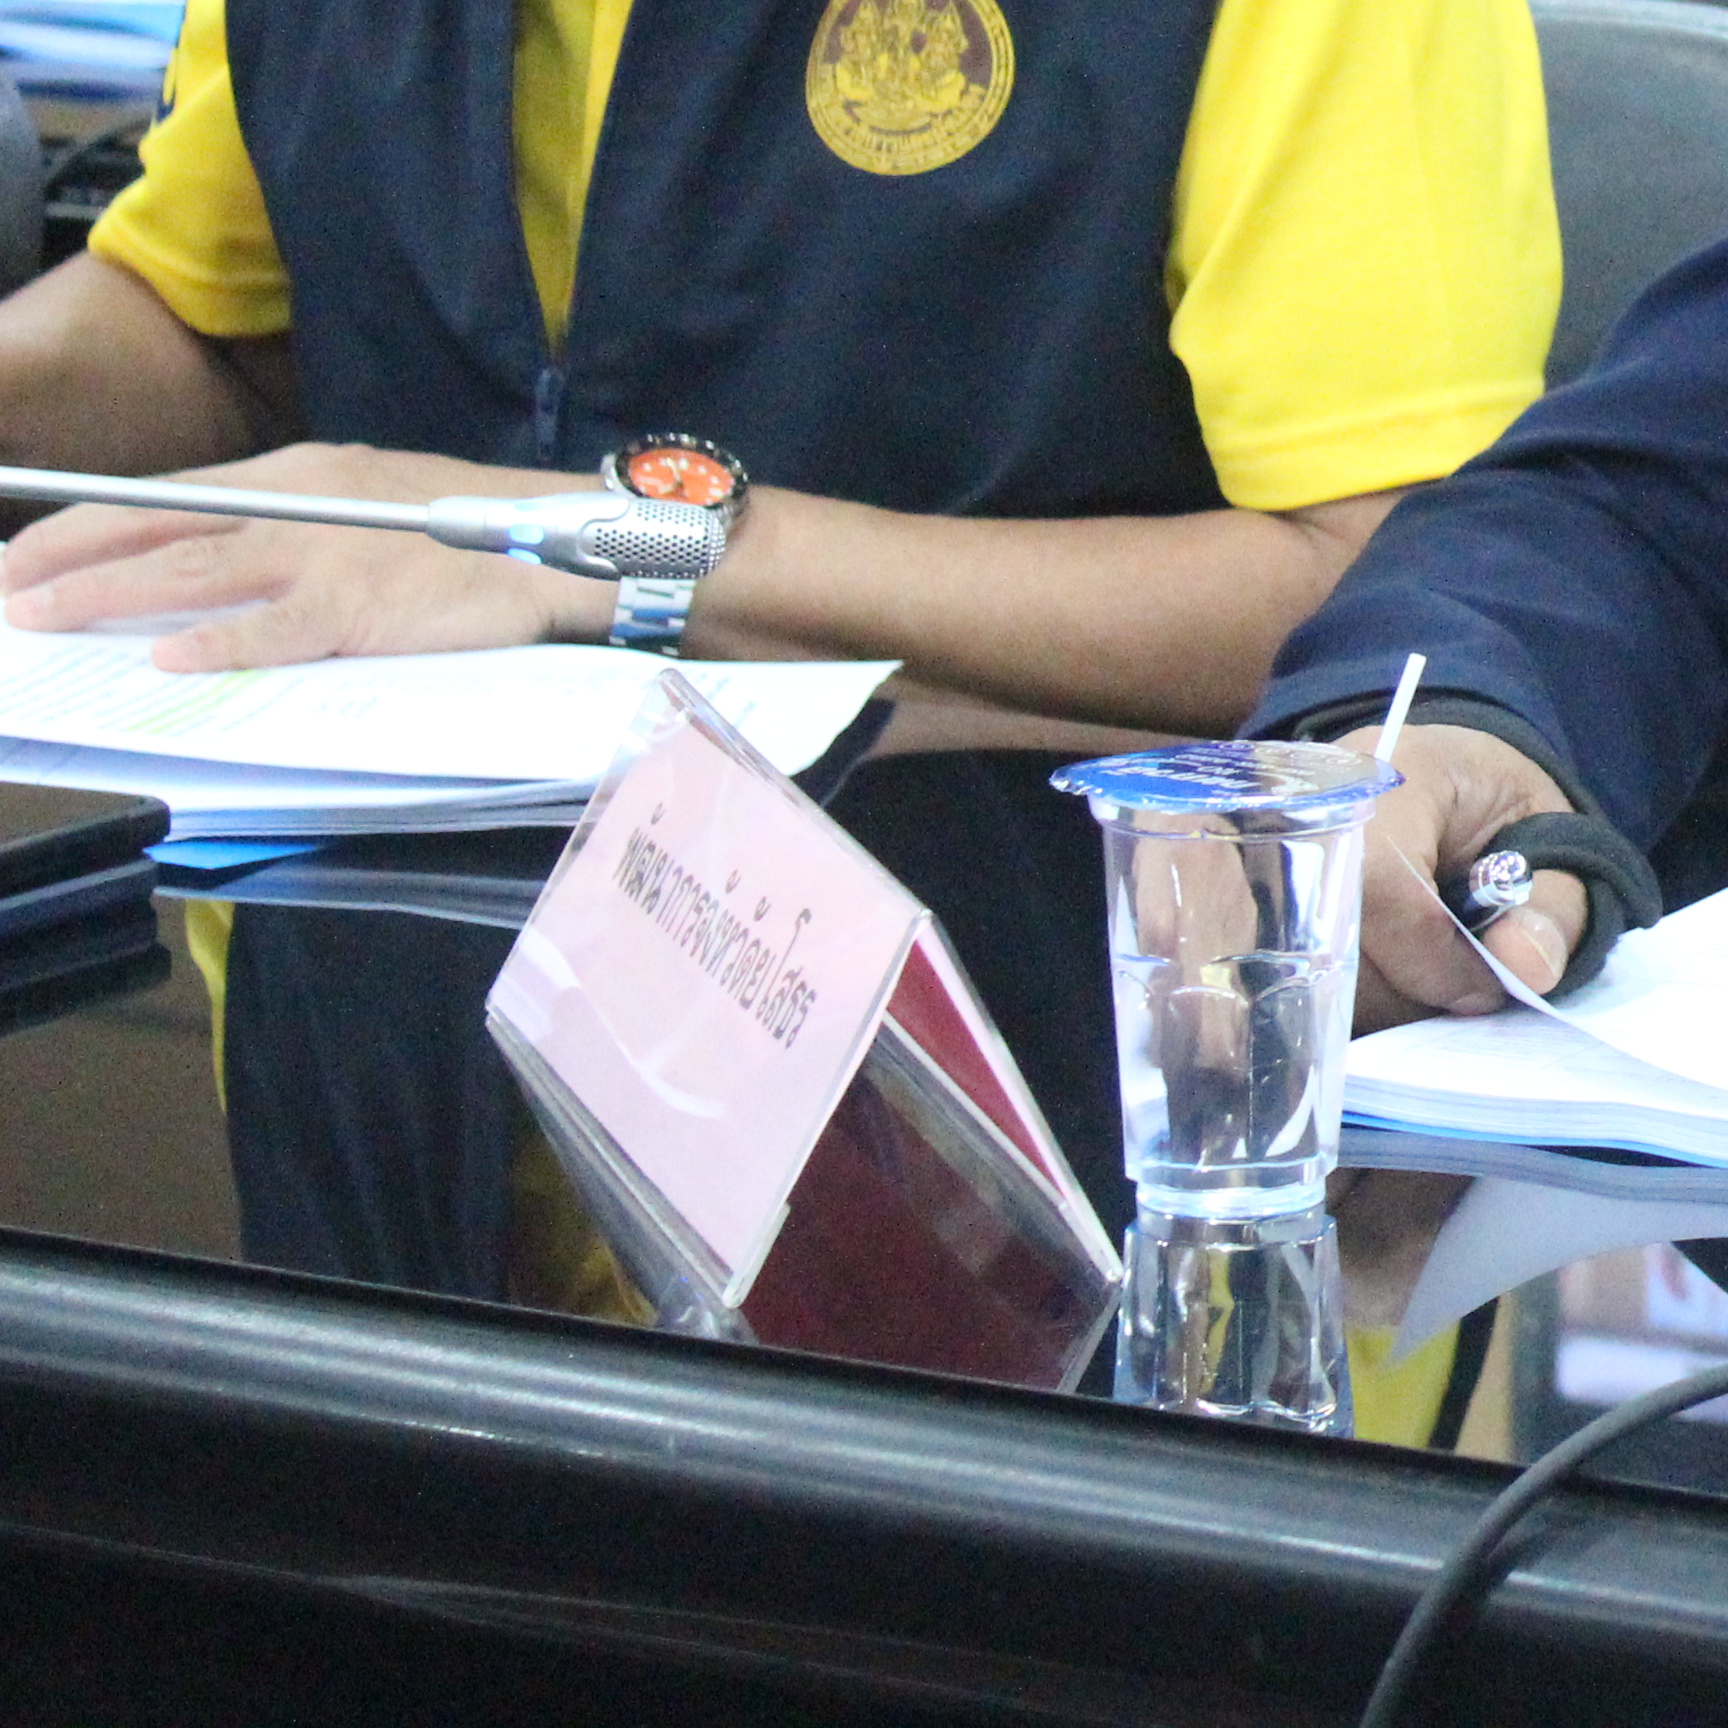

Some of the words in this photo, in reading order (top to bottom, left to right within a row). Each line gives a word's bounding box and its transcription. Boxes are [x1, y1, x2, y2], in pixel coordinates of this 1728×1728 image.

[612, 803, 816, 1050] พัฒนาการจังหวัดยโสธร
